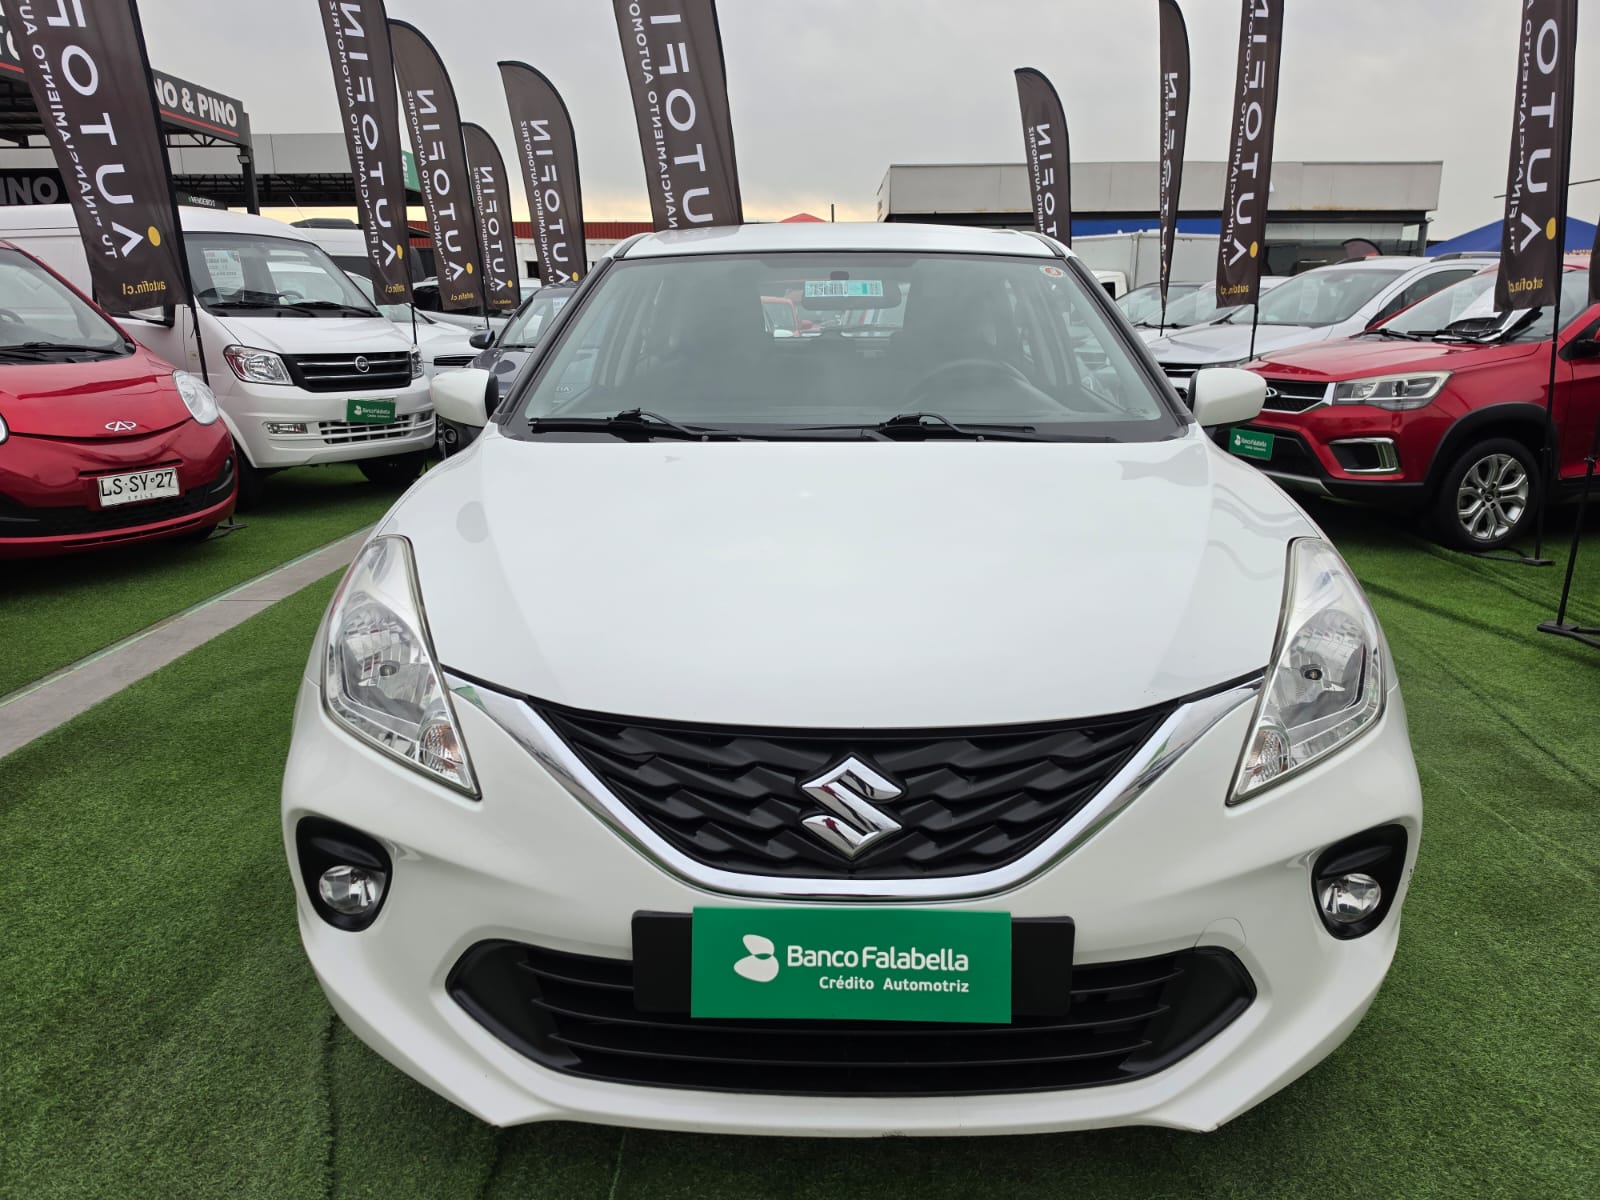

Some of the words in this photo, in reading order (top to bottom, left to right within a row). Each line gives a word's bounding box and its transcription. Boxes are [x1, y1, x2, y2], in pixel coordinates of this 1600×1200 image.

[181, 87, 196, 114] &
[197, 92, 238, 128] PINO
[819, 975, 875, 991] Crédito
[883, 977, 970, 993] Automotriz
